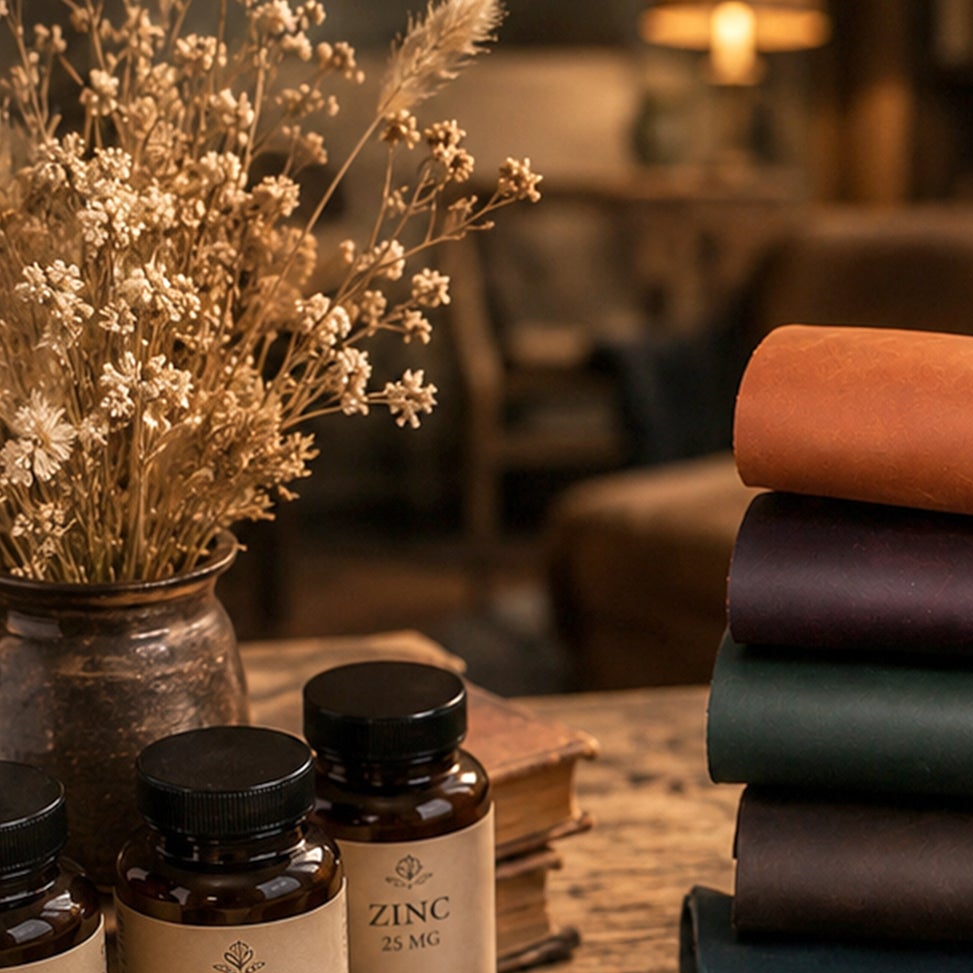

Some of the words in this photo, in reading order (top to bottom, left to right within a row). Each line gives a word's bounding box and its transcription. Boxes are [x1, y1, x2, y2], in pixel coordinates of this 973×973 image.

[367, 896, 450, 927] ZINC
[381, 935, 403, 952] 25
[408, 930, 441, 950] MG
